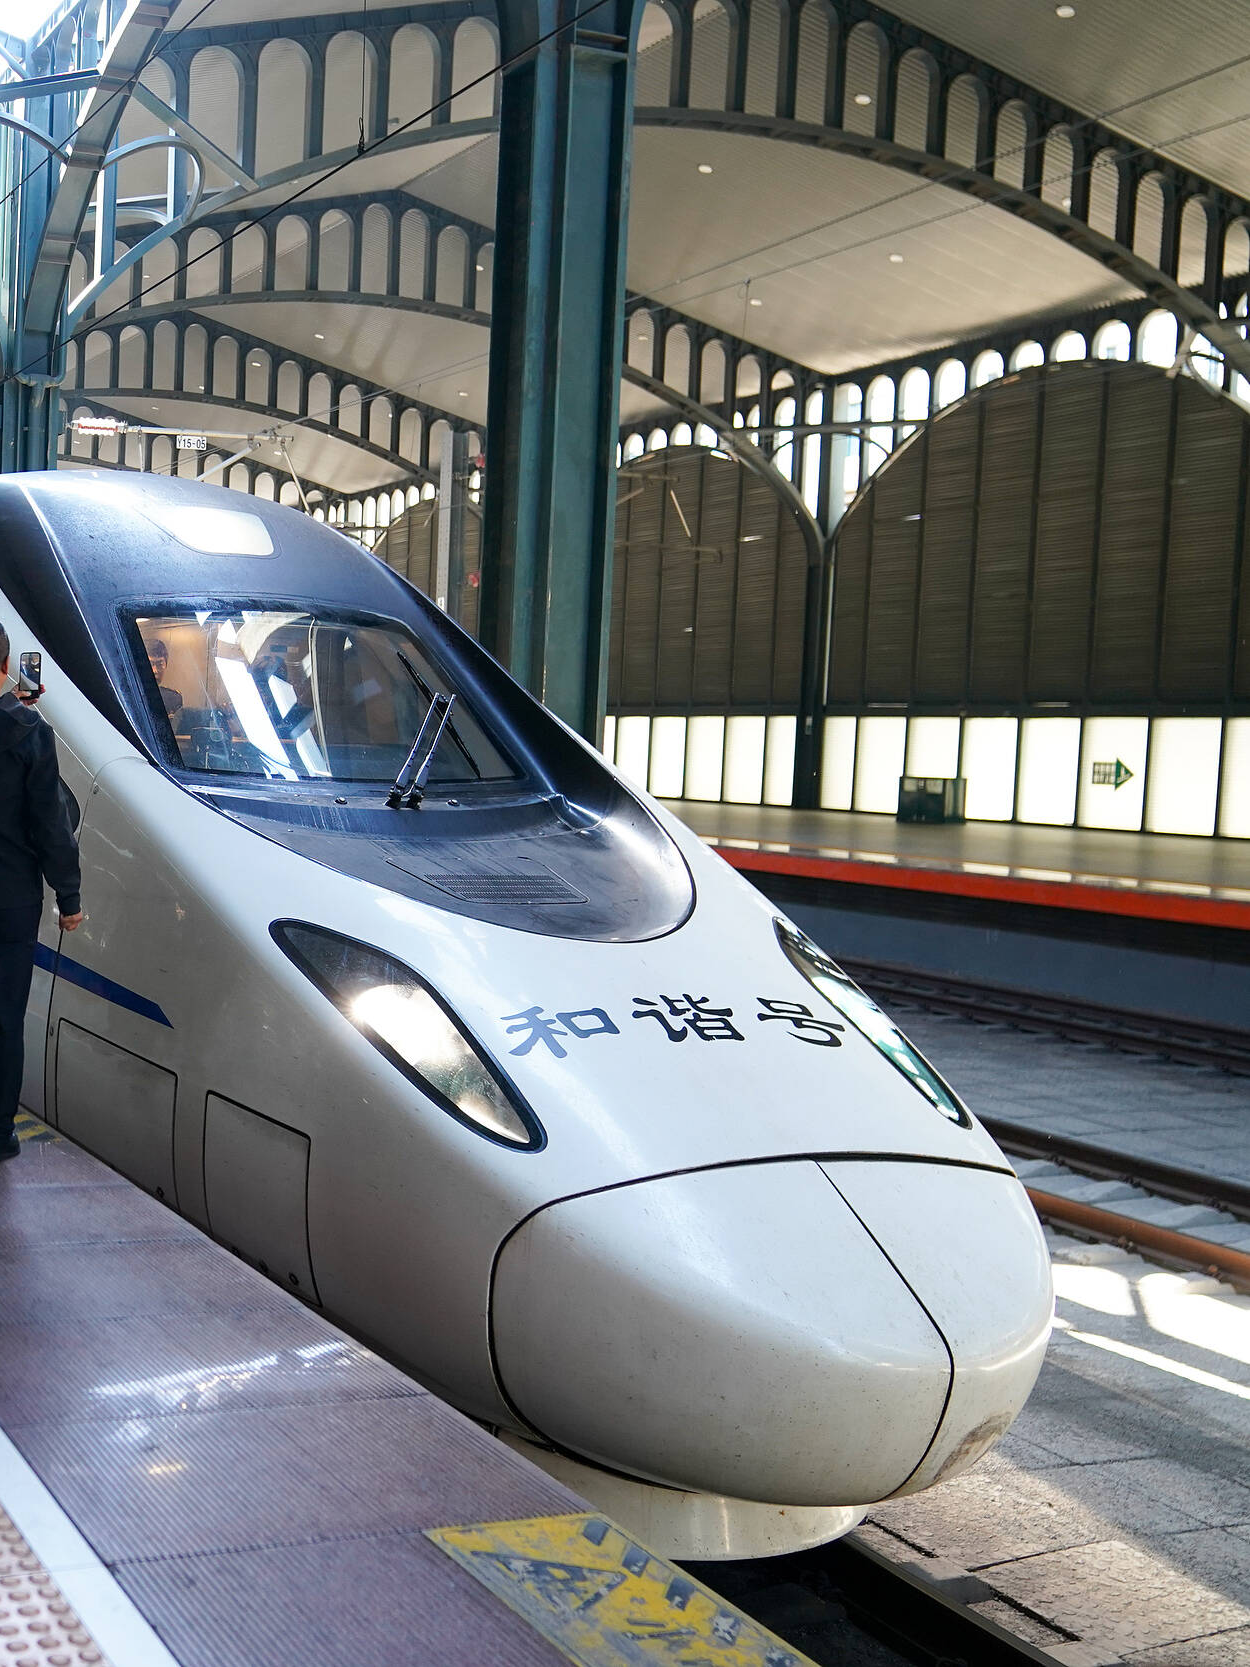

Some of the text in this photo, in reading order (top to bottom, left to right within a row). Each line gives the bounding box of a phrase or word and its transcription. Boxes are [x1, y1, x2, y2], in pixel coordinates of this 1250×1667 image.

[177, 436, 206, 449] Y15-05
[500, 993, 845, 1059] 和谐号
